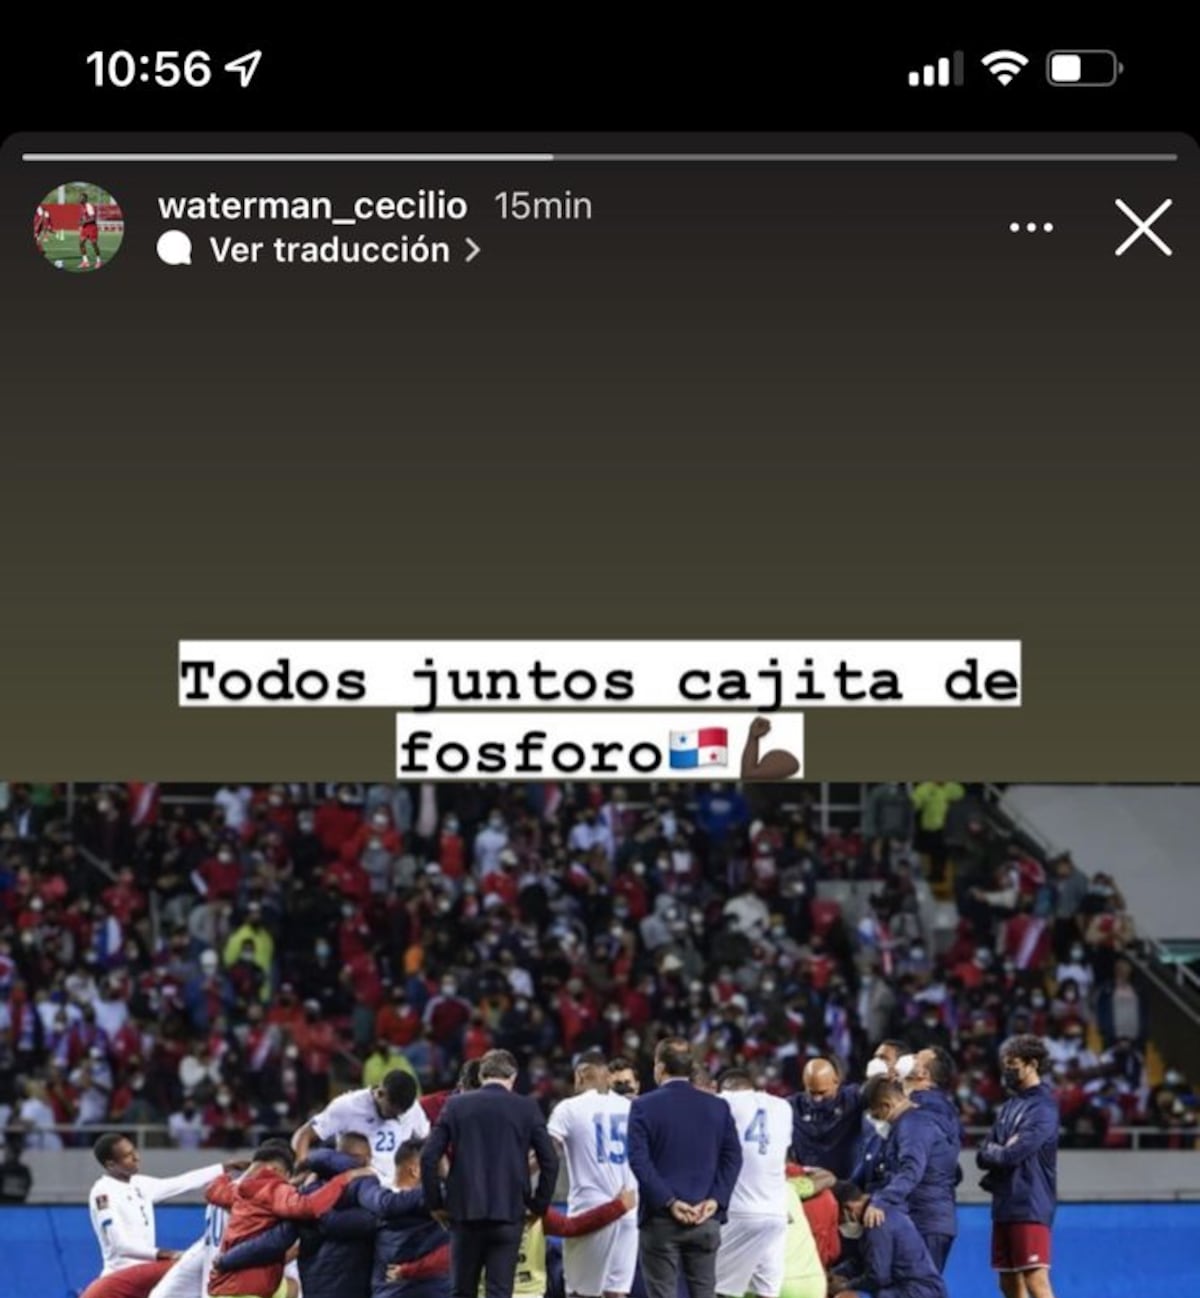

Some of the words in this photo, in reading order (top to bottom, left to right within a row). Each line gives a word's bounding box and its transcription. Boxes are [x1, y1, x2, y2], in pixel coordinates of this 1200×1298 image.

[375, 1131, 396, 1152] 23
[593, 1112, 630, 1164] 15
[744, 1108, 770, 1155] 4
